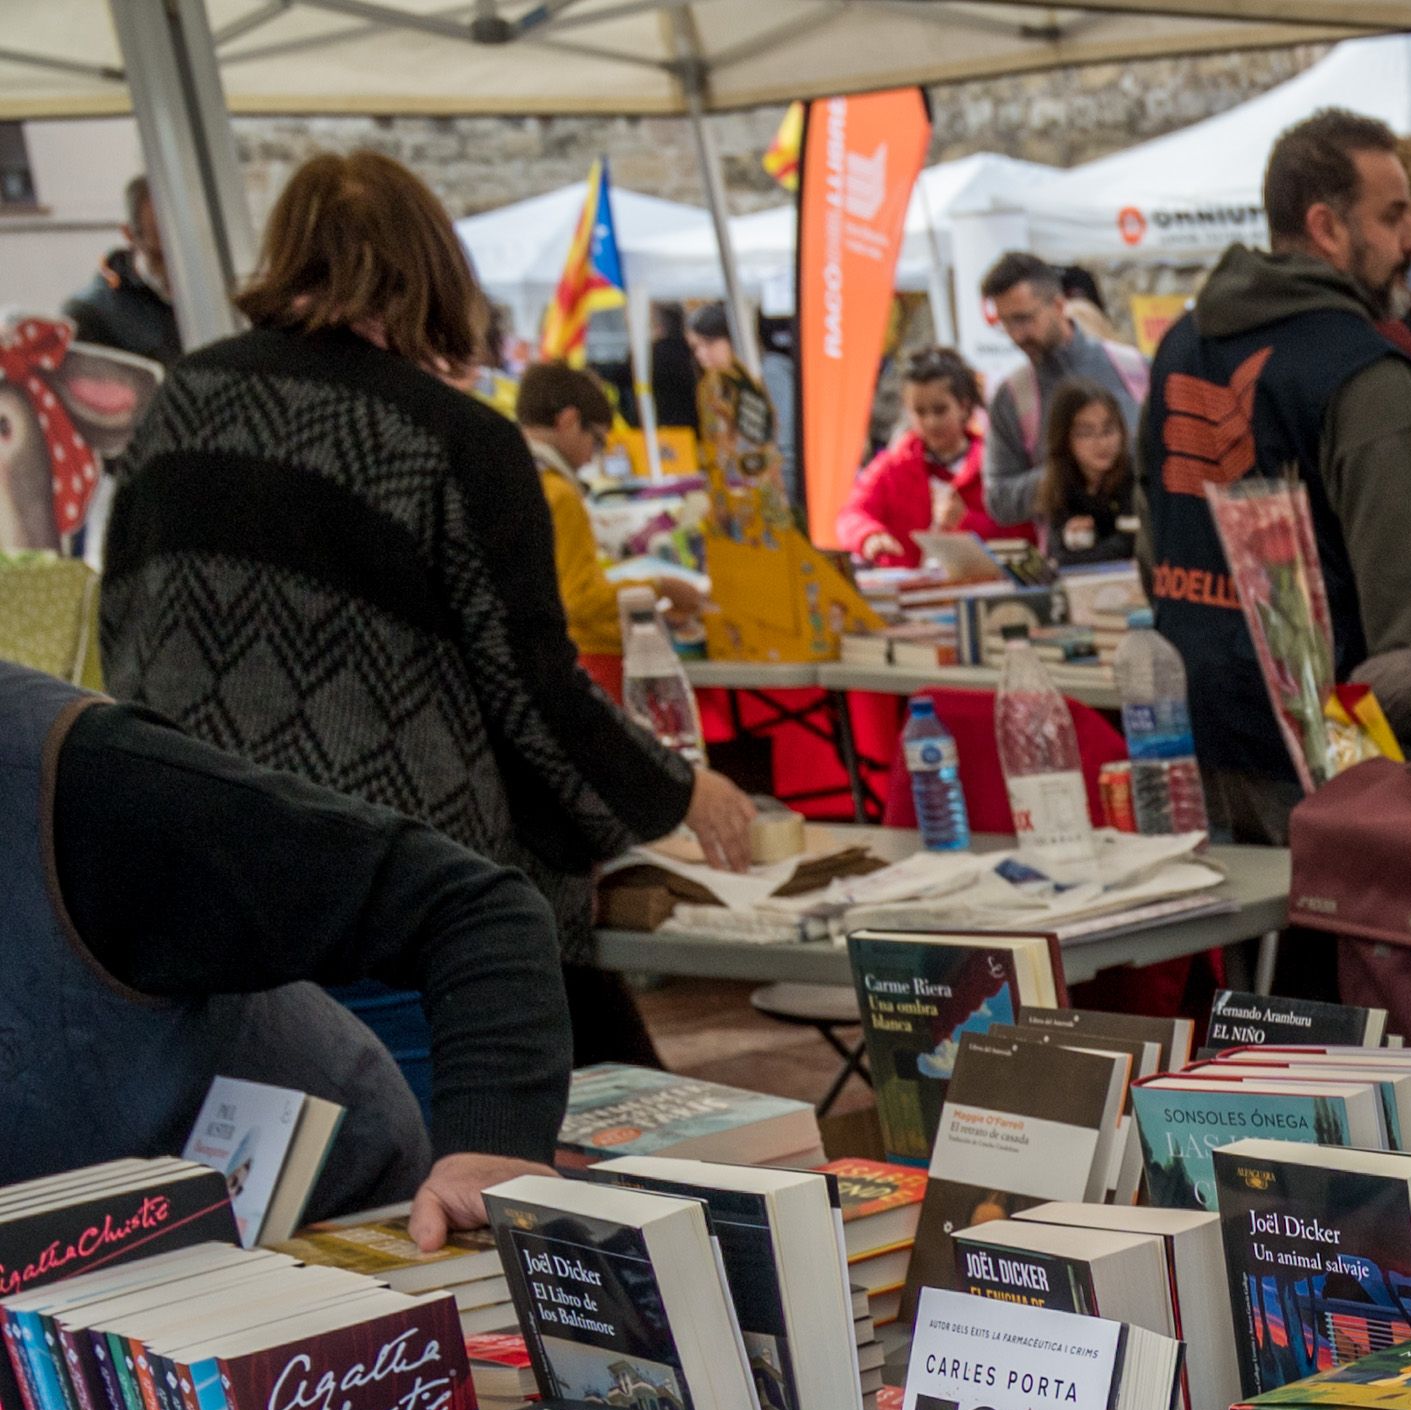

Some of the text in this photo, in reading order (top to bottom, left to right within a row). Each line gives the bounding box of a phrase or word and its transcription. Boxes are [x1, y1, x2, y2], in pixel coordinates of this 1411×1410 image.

[1213, 1023, 1266, 1044] EL NIÑO
[1163, 1107, 1308, 1131] SONSOLES ÓNEGA
[1248, 1208, 1341, 1244] Joël Dicker
[523, 1249, 602, 1287] Joël Dicker
[967, 1252, 1051, 1292] JOËL DICKER
[1253, 1243, 1370, 1279] Un animal salvaje
[548, 1285, 582, 1309] Libro
[559, 1307, 616, 1336] Baltimore
[925, 1354, 1078, 1403] CARLES PORTA
